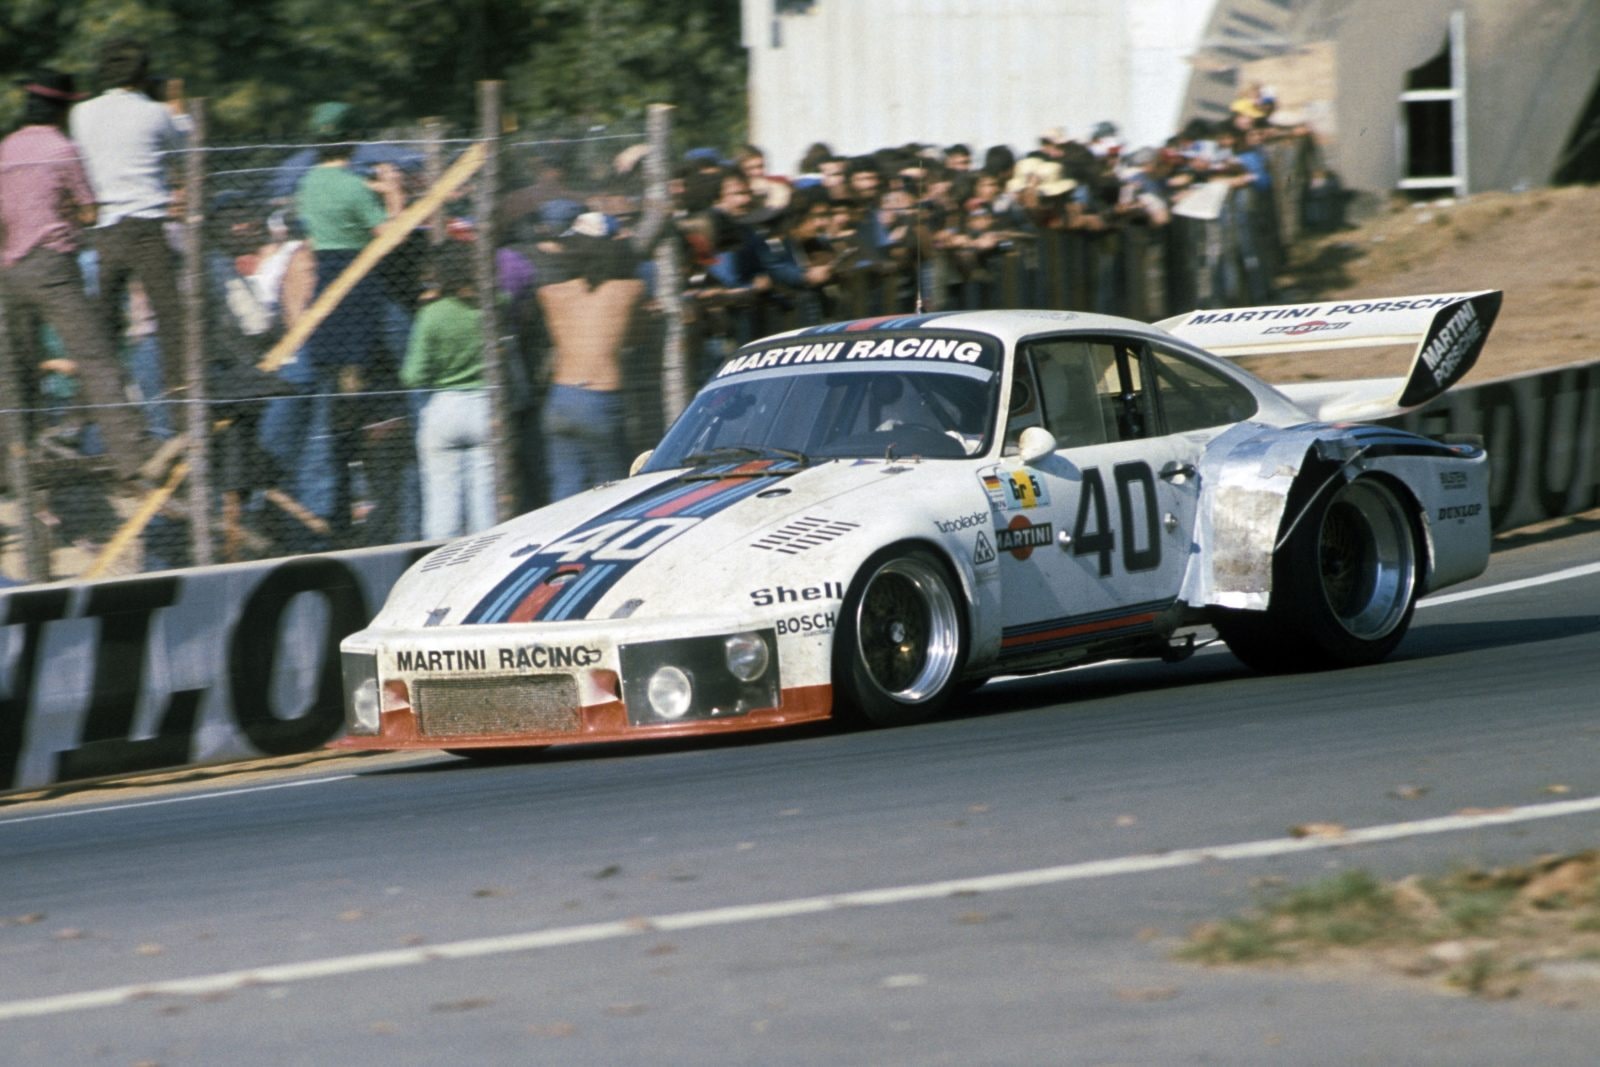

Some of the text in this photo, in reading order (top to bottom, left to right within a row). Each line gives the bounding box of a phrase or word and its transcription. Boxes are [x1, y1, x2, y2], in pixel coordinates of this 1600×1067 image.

[1189, 306, 1322, 325] MARTINI
[1422, 300, 1477, 371] MARTINI
[717, 338, 982, 377] MARTINI RACING
[1433, 320, 1482, 388] PORSCHE
[1008, 475, 1042, 500] Gr 5
[1074, 460, 1163, 577] 40
[1438, 504, 1481, 520] DUNLOP
[540, 518, 703, 562] 40
[996, 526, 1050, 549] MARTINI
[750, 582, 842, 606] Shell
[776, 612, 835, 635] BOSCH
[397, 646, 590, 672] MARTINI RACING
